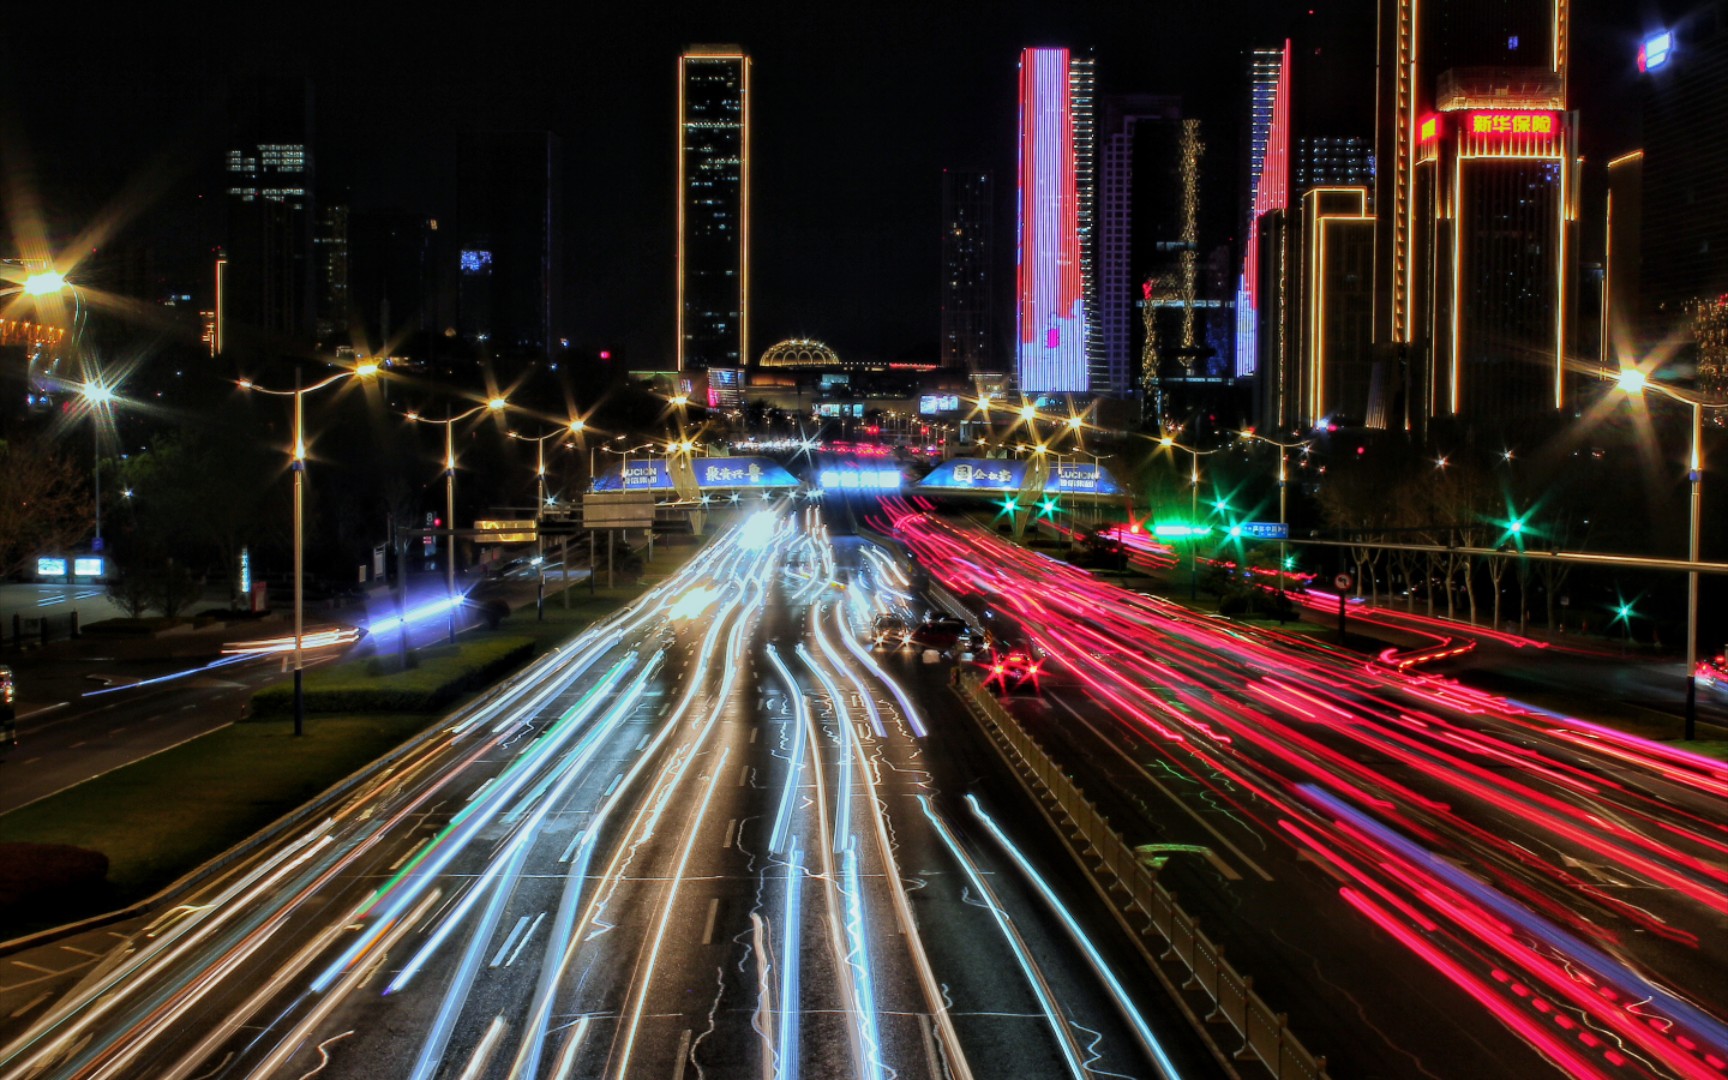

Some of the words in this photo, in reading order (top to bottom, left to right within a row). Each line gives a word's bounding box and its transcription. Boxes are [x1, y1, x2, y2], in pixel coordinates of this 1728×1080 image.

[1473, 115, 1551, 133] 新华保险
[623, 467, 657, 476] UCION
